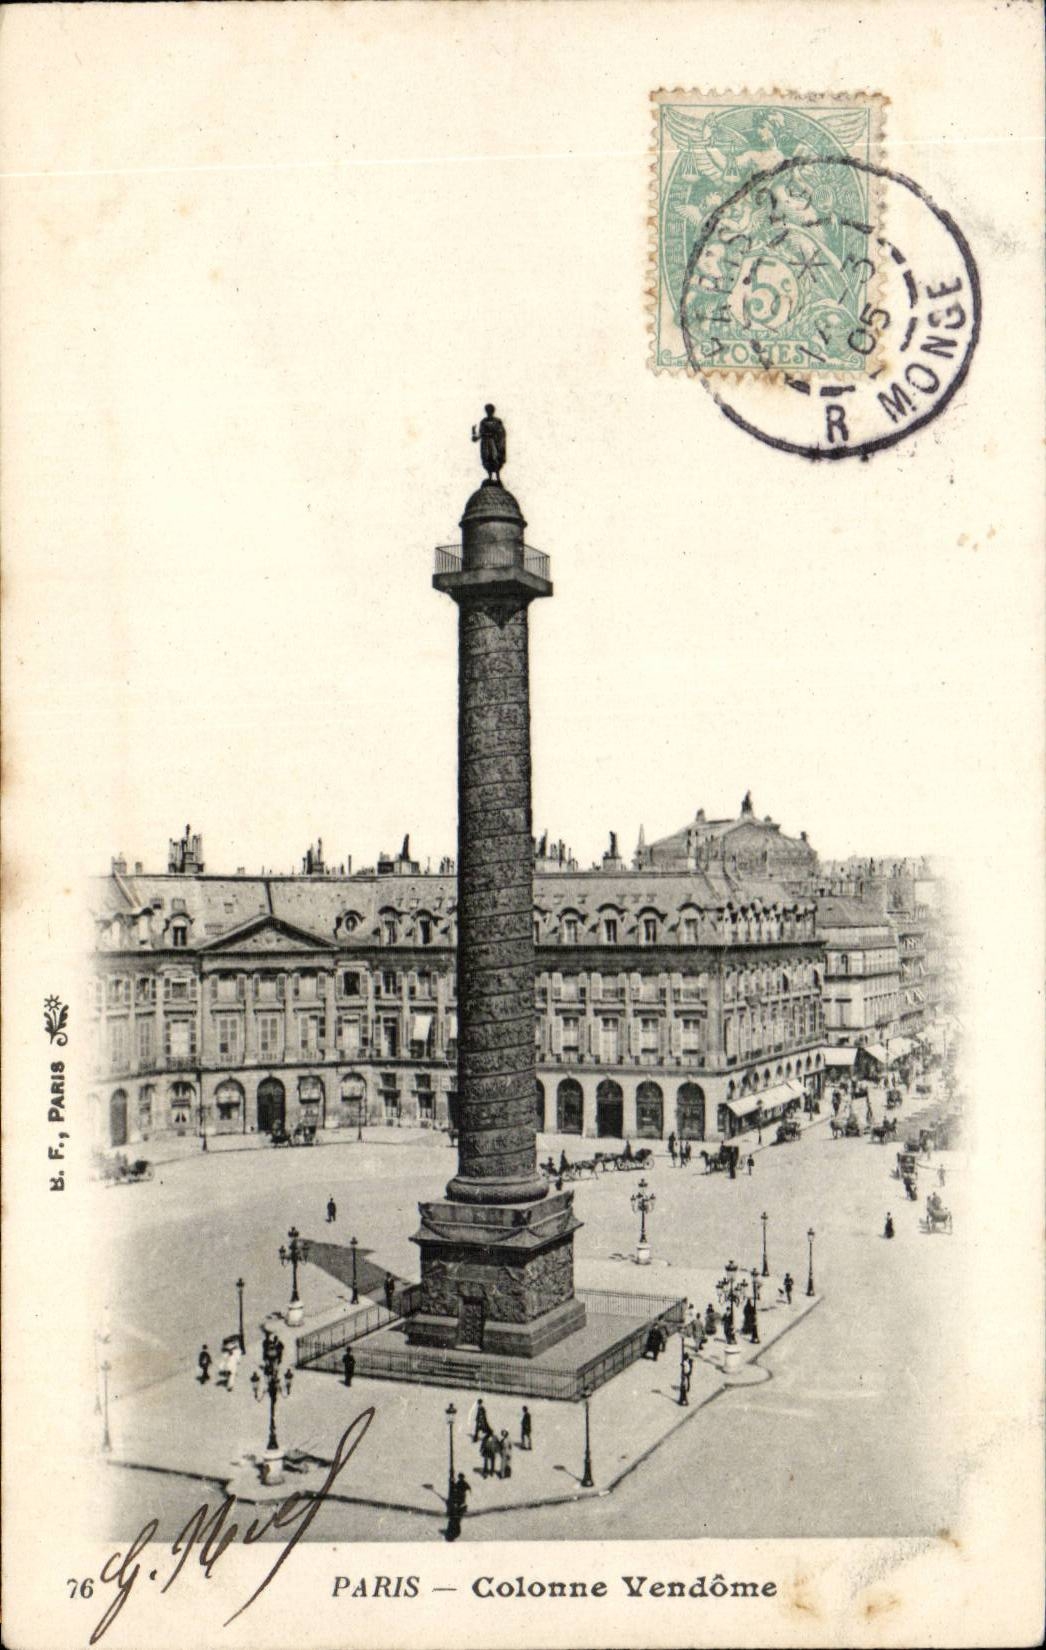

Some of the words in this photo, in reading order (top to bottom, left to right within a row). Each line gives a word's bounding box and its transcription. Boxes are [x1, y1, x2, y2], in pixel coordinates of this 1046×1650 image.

[825, 404, 849, 443] R
[877, 276, 967, 423] MONGE
[847, 302, 891, 355] 05
